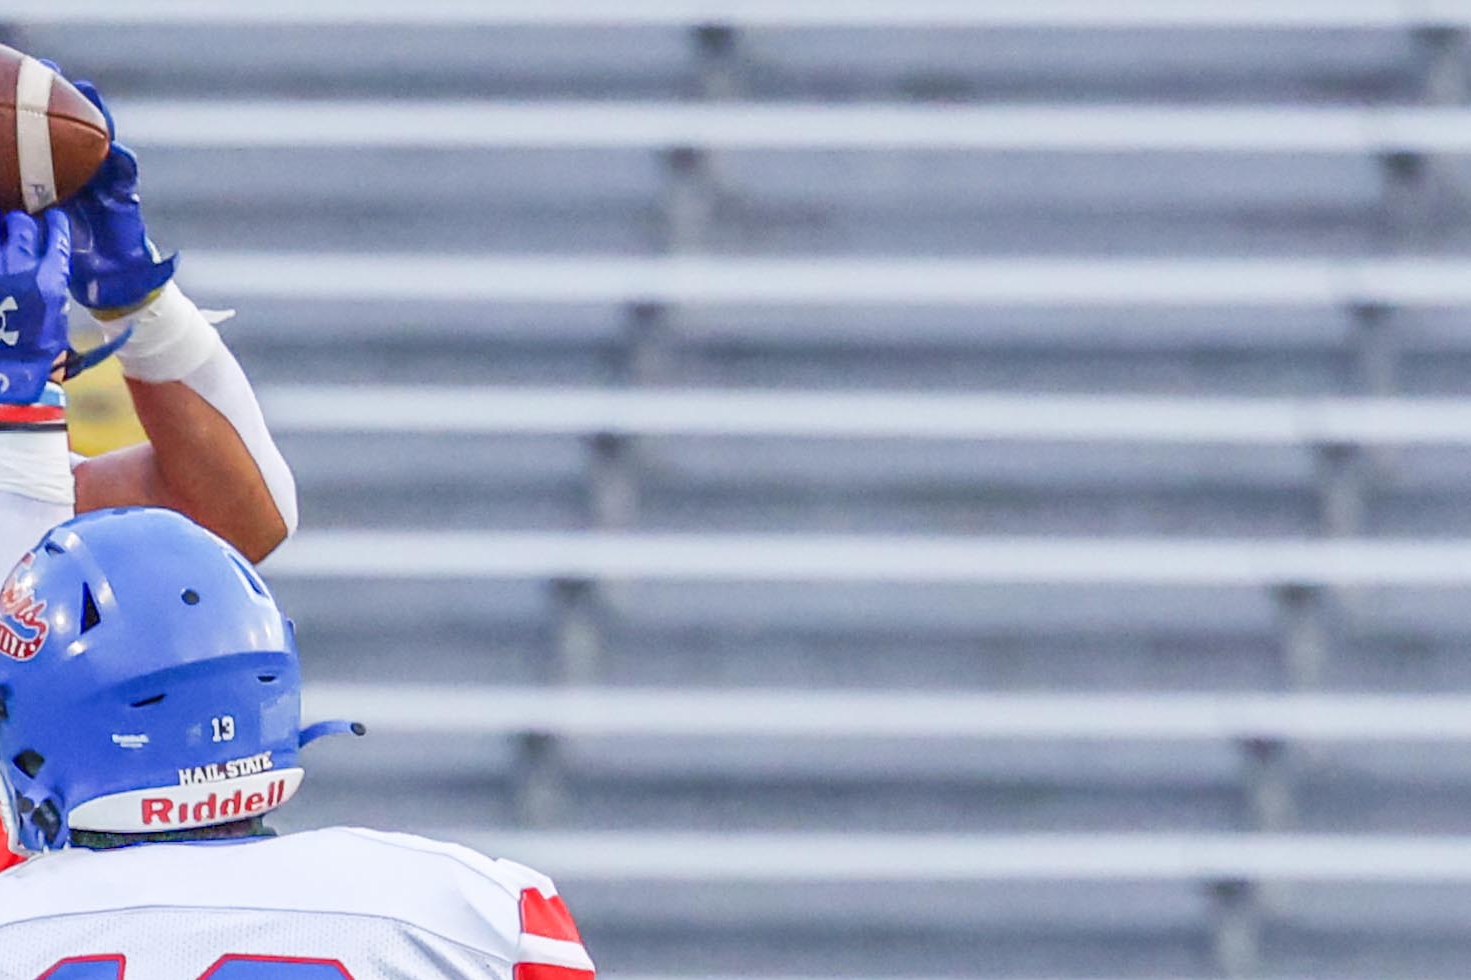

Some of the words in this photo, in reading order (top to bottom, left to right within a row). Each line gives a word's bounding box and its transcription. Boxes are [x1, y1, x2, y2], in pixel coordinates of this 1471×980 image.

[211, 715, 235, 743] 13
[178, 762, 226, 786] HAIL
[225, 750, 274, 779] STATE
[141, 779, 285, 826] Riddell
